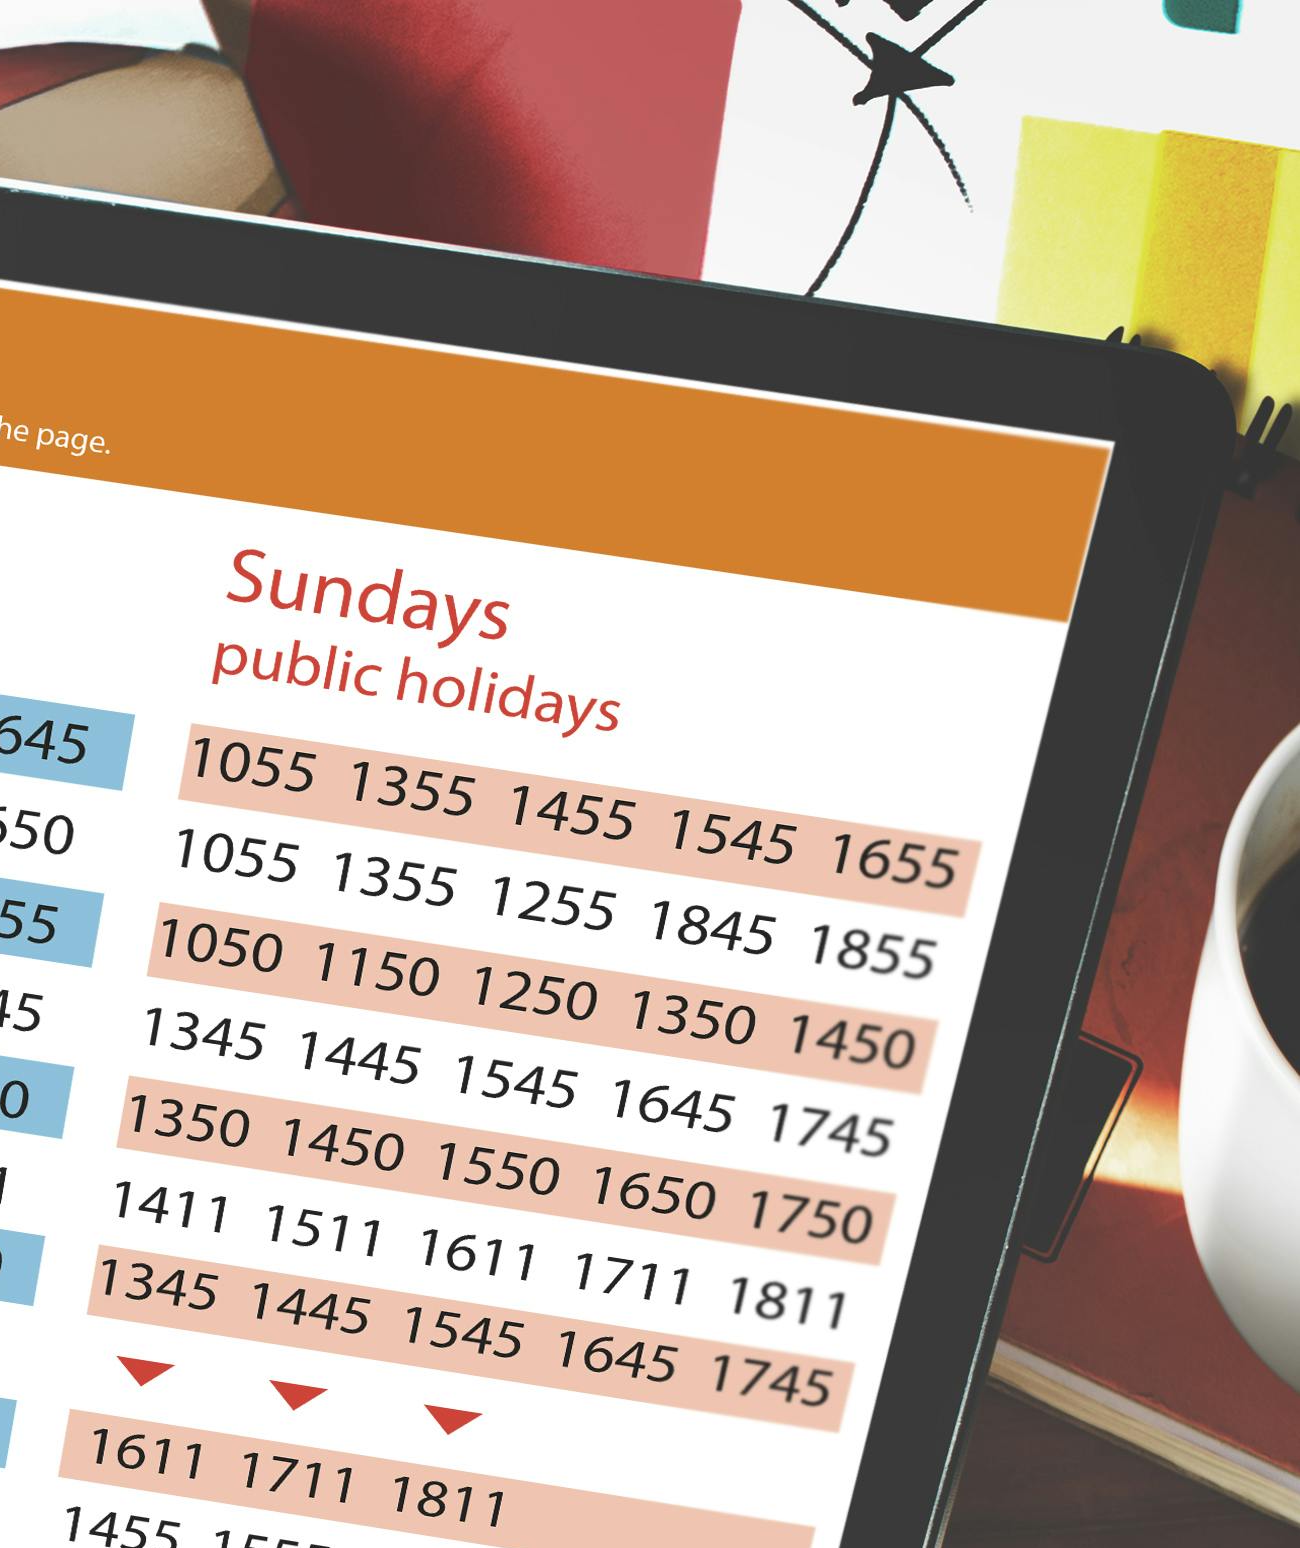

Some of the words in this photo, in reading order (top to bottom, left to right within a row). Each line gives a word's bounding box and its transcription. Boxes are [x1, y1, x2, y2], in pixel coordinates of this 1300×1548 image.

[36, 428, 109, 456] page.
[227, 549, 509, 648] Sundays
[213, 640, 381, 696] public
[398, 657, 619, 737] holidays
[195, 737, 317, 792] 1055
[353, 761, 476, 816] 1355
[513, 785, 637, 841] 1455
[673, 809, 798, 865] 1545
[835, 834, 958, 888] 1655
[147, 1007, 266, 1061] 1345
[302, 1031, 422, 1085] 1445
[458, 1055, 579, 1109] 1545
[615, 1079, 736, 1133] 1645
[773, 1104, 893, 1156] 1745
[102, 1258, 219, 1310] 1345
[254, 1282, 371, 1334] 1445
[407, 1306, 525, 1358] 1545
[560, 1330, 678, 1382] 1645
[715, 1355, 832, 1406] 1745
[93, 1428, 202, 1480] 1611
[243, 1452, 352, 1504] 1711
[394, 1476, 504, 1528] 1811
